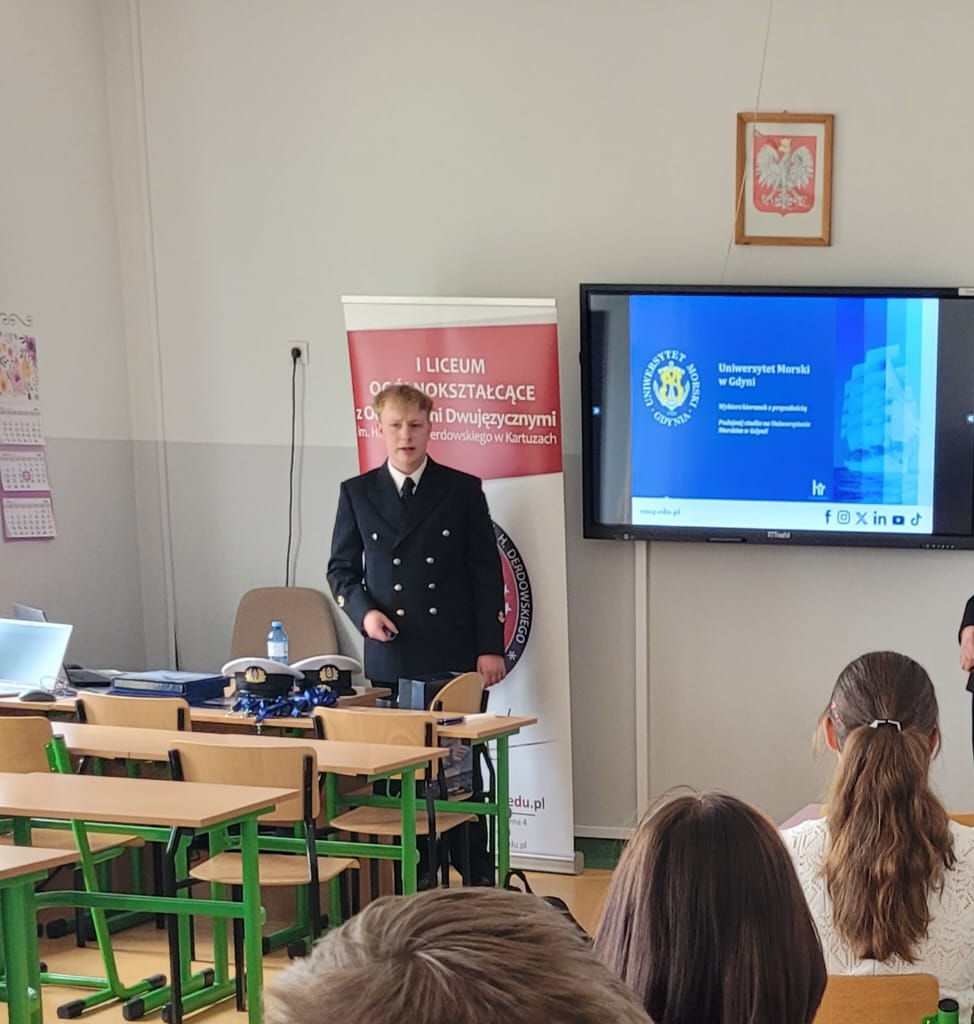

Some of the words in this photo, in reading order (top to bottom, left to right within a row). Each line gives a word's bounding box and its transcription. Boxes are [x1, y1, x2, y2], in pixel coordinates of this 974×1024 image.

[416, 357, 421, 372] I
[426, 357, 485, 374] LICEUM
[718, 363, 775, 375] Uniwersytet
[777, 364, 810, 374] Morski
[642, 350, 687, 407] UNIWERSYTET
[686, 363, 700, 408] MORSKI
[718, 378, 727, 386] w
[728, 376, 756, 388] Gdyni
[369, 378, 536, 404] ONOKSZTAŁCĄCE
[446, 409, 557, 431] Dwujęzycznymi
[654, 411, 691, 427] GDYNIA
[430, 430, 492, 445] erdowskiego
[495, 434, 503, 442] w
[505, 431, 557, 445] Kartuzach
[507, 548, 531, 644] DERDOWSKIEGO
